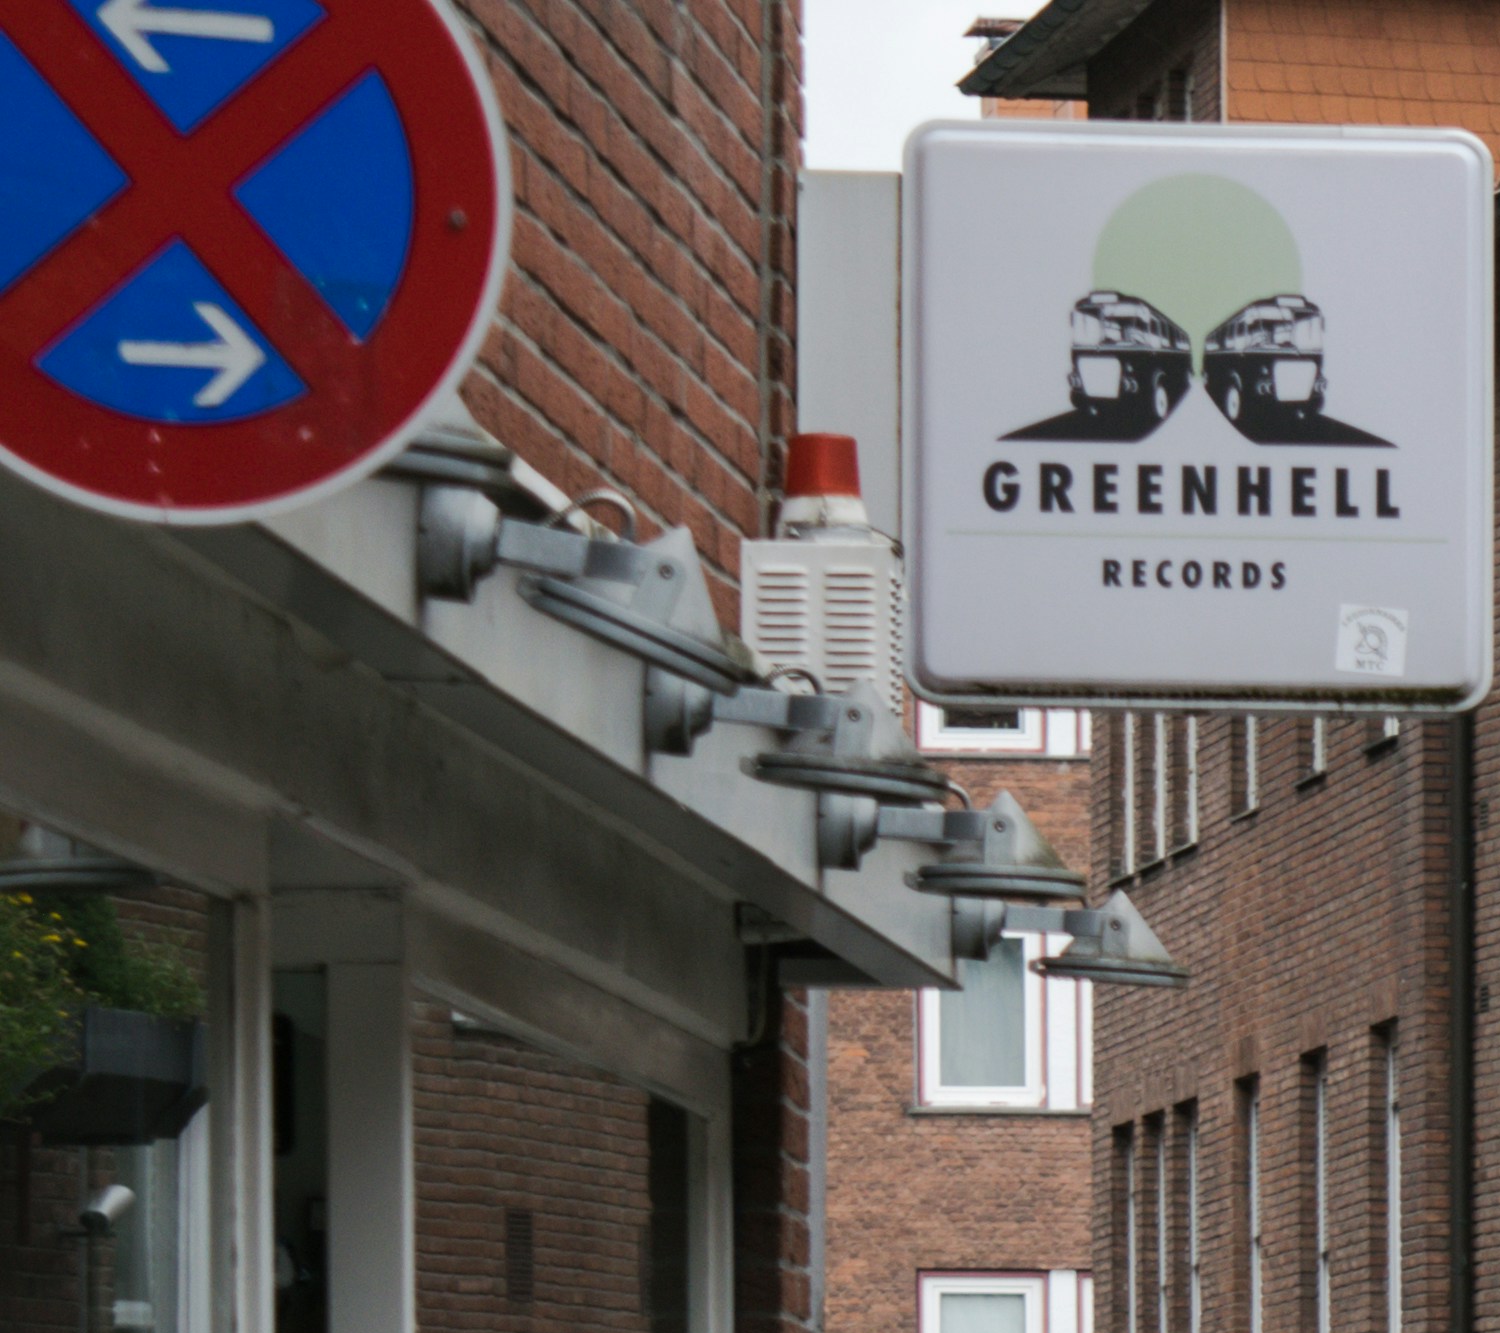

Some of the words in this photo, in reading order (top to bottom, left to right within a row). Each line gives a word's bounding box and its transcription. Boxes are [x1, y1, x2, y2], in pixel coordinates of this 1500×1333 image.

[982, 460, 1401, 520] GREENHELL
[1102, 559, 1288, 591] RECORDS
[1355, 657, 1386, 671] MTC
